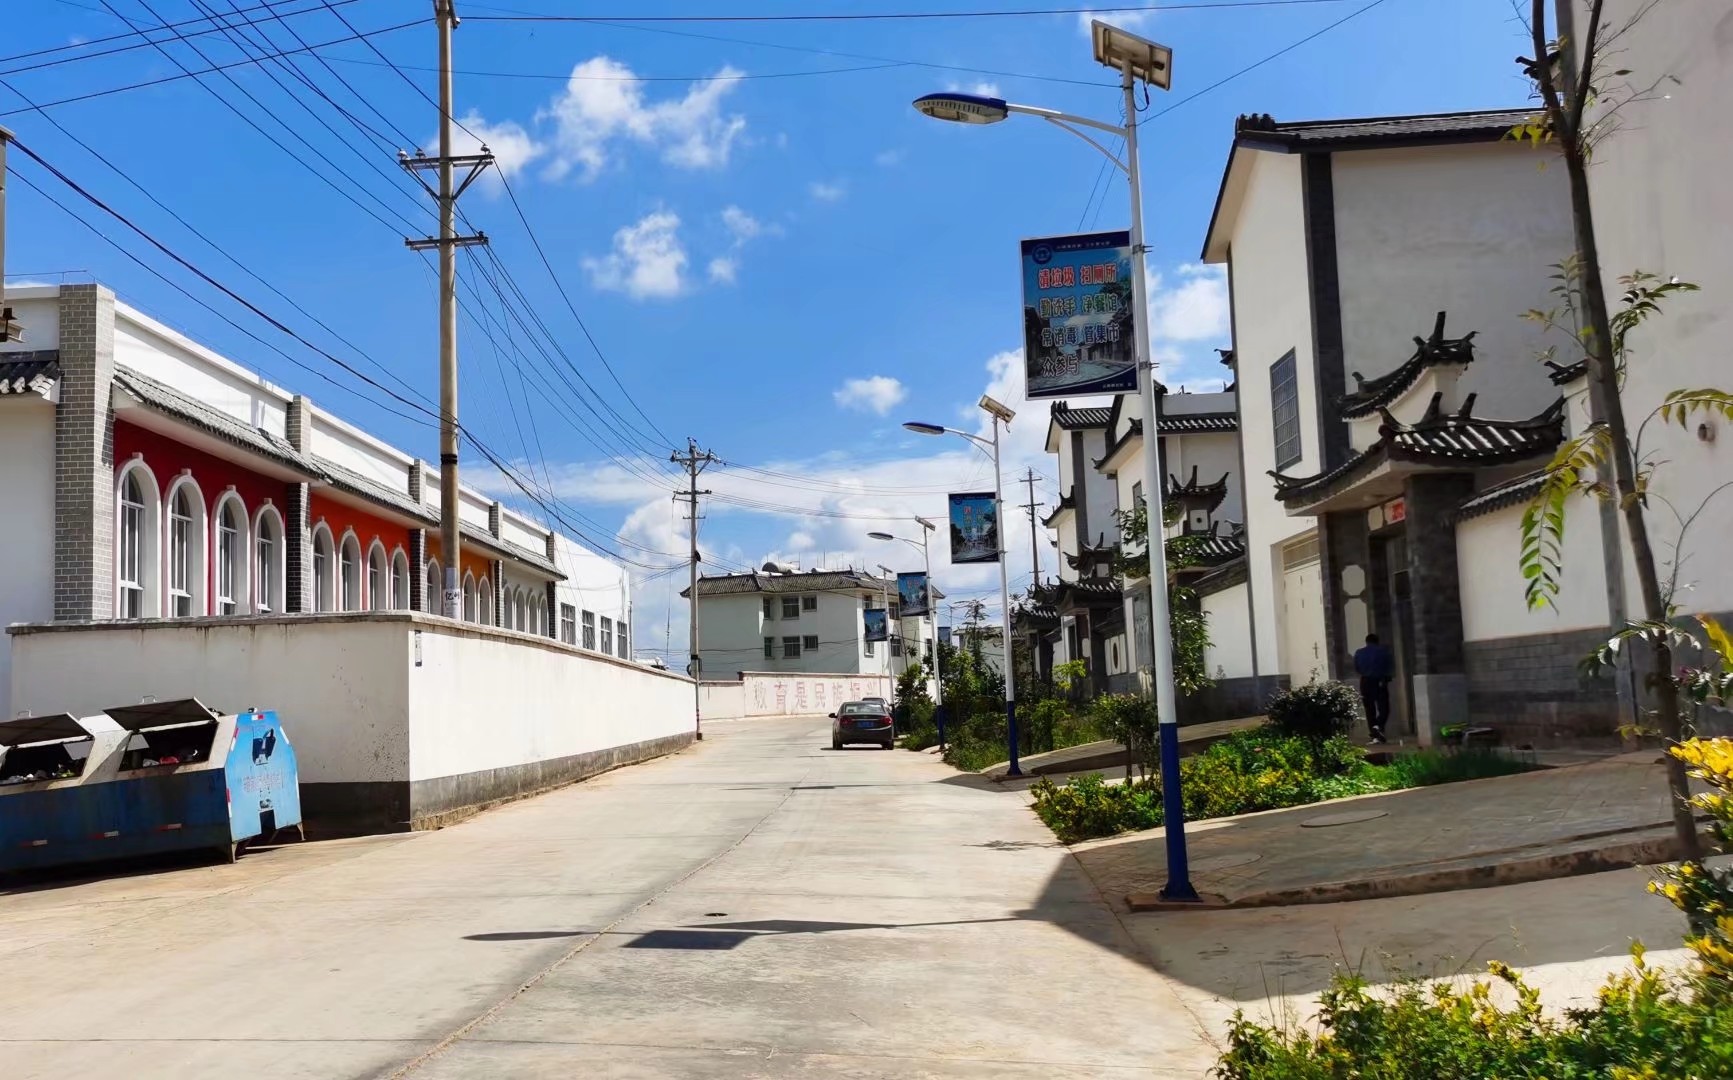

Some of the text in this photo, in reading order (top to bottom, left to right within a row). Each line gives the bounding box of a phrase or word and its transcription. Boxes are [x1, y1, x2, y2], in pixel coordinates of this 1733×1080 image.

[1039, 266, 1075, 289] 清垃圾
[1039, 292, 1118, 318] 勤洗手 净餐馆
[1041, 322, 1120, 347] 常消毒 管集市
[1042, 355, 1079, 377] 众参与
